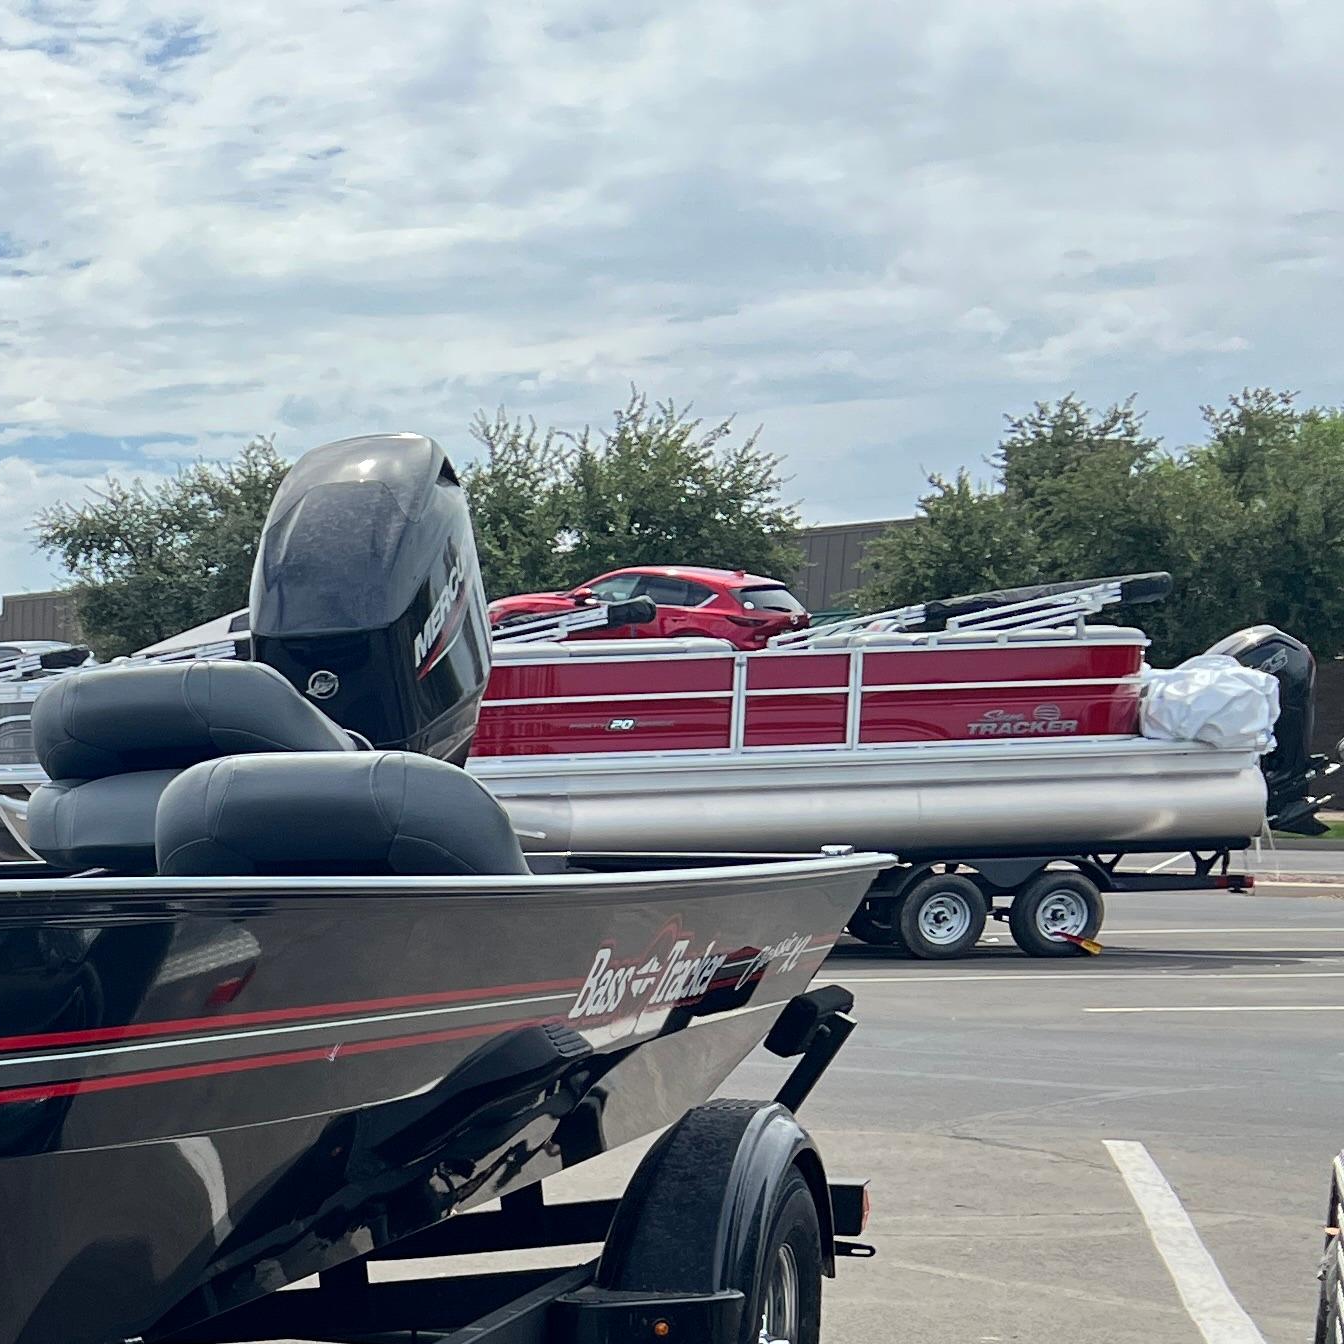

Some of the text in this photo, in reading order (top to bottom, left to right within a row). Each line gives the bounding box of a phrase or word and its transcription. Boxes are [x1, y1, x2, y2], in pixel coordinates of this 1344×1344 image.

[414, 546, 464, 668] MERCU
[610, 719, 634, 730] 20
[967, 720, 1078, 735] TRACKER
[568, 948, 636, 1019] Bass
[648, 940, 728, 1004] Tracker
